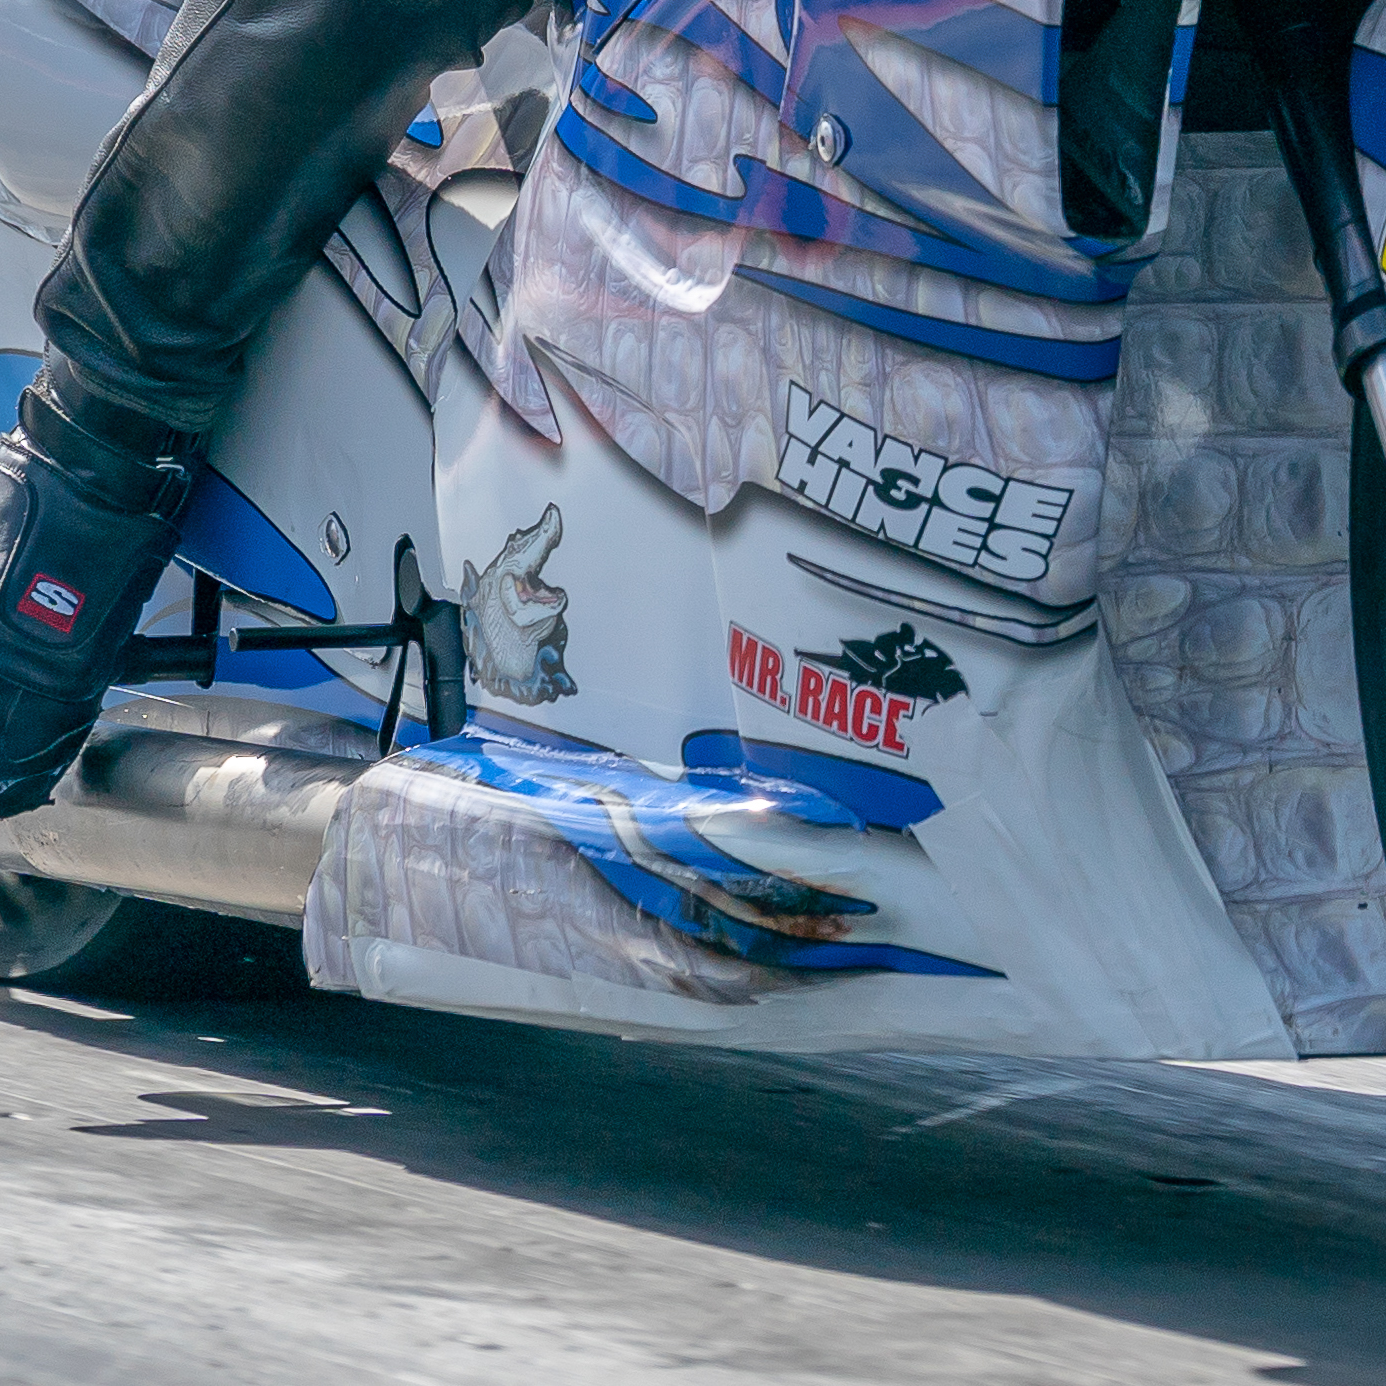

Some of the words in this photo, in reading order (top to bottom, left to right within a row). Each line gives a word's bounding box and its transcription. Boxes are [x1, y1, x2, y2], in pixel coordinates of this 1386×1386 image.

[775, 436, 1054, 582] HINES
[785, 380, 1074, 538] VANCE
[728, 621, 791, 714] MR.
[793, 655, 915, 759] RACE
